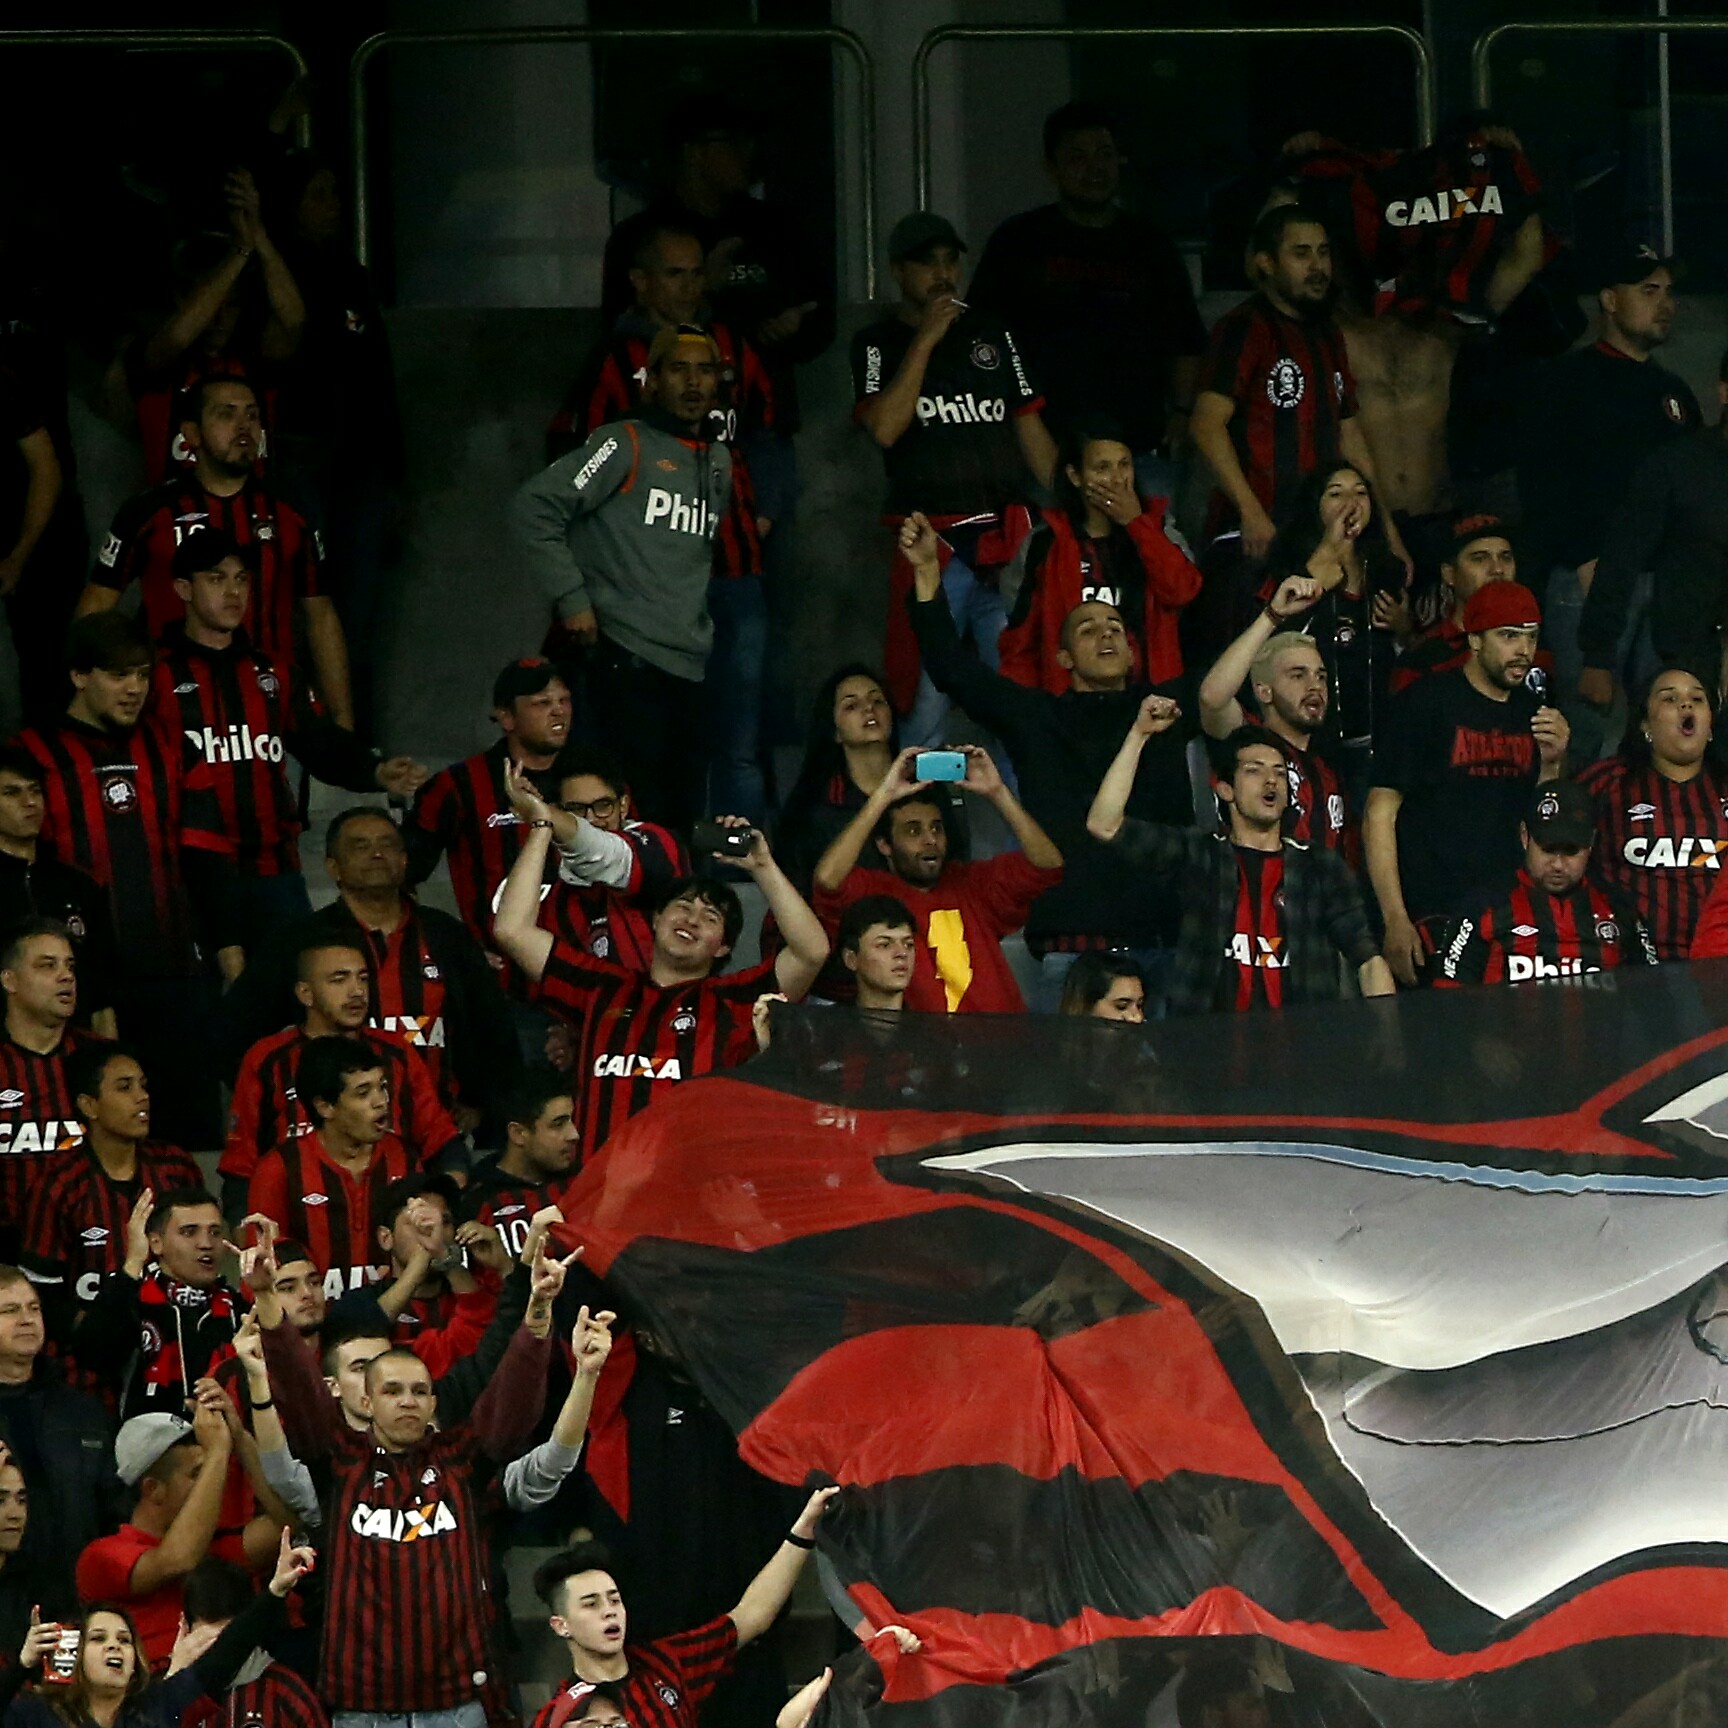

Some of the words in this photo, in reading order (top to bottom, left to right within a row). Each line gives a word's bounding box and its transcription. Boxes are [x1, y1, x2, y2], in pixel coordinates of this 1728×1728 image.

[1385, 184, 1503, 227] CAIXA
[917, 395, 1005, 426] Philco
[574, 437, 618, 492] NETSHOES
[594, 1055, 682, 1080] CAIXA
[494, 1217, 528, 1258] 10
[351, 1500, 459, 1543] CAIXA
